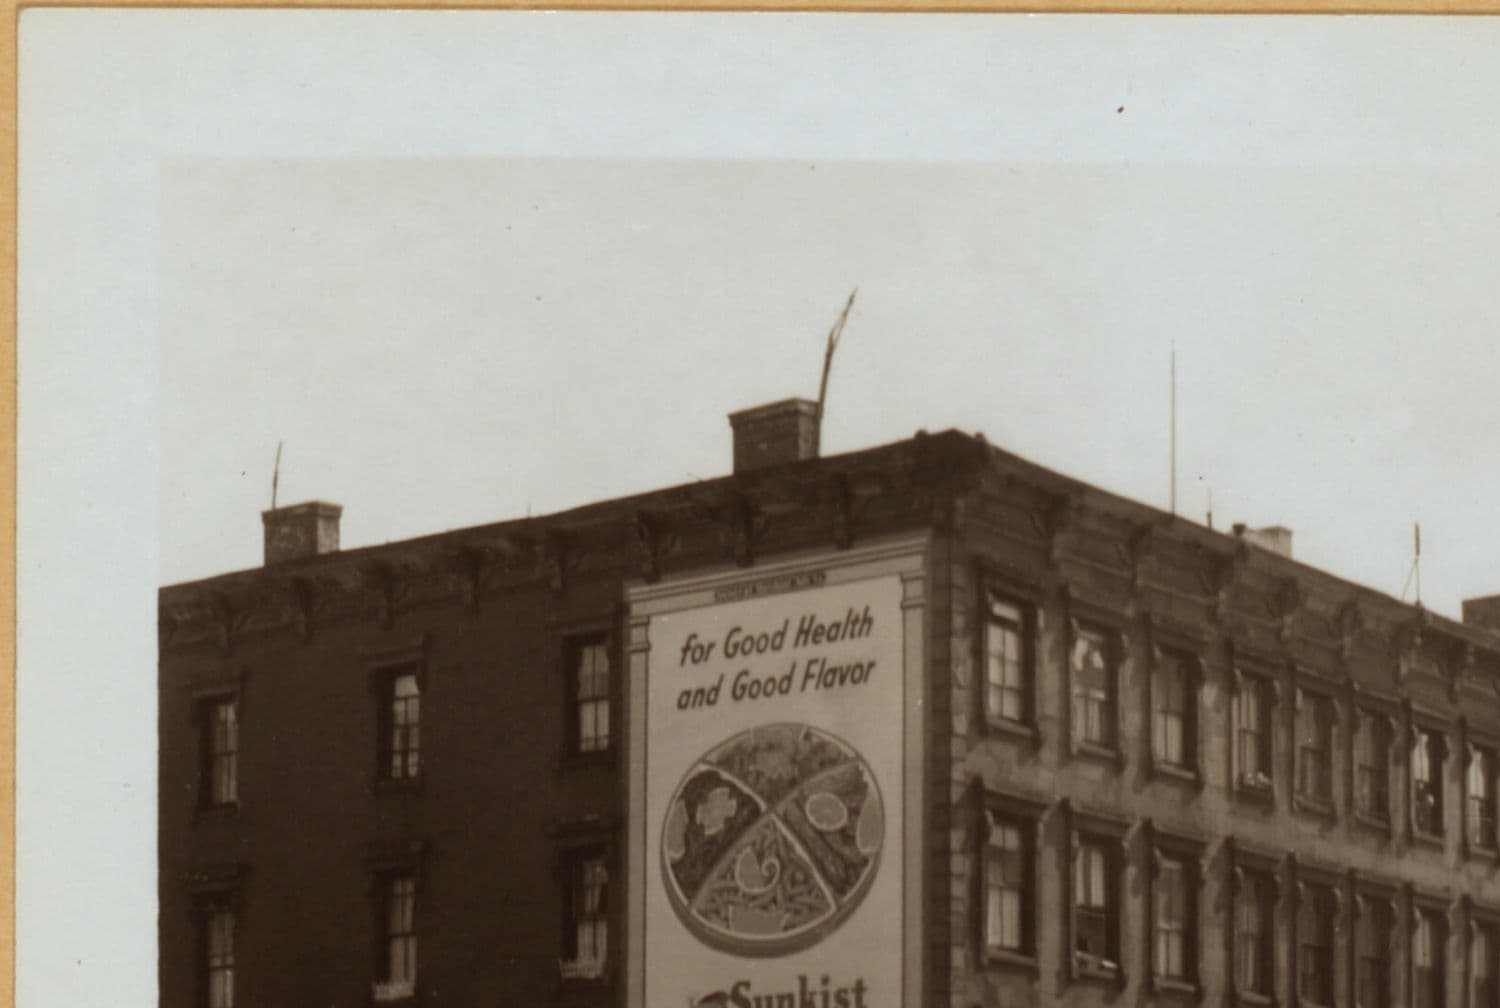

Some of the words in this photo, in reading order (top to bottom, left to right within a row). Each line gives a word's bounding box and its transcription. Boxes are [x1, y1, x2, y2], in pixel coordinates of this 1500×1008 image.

[680, 633, 716, 668] for
[723, 618, 789, 660] Good
[793, 605, 875, 648] Health
[677, 672, 724, 711] and
[731, 661, 797, 702] Good
[801, 657, 877, 693] Flavor
